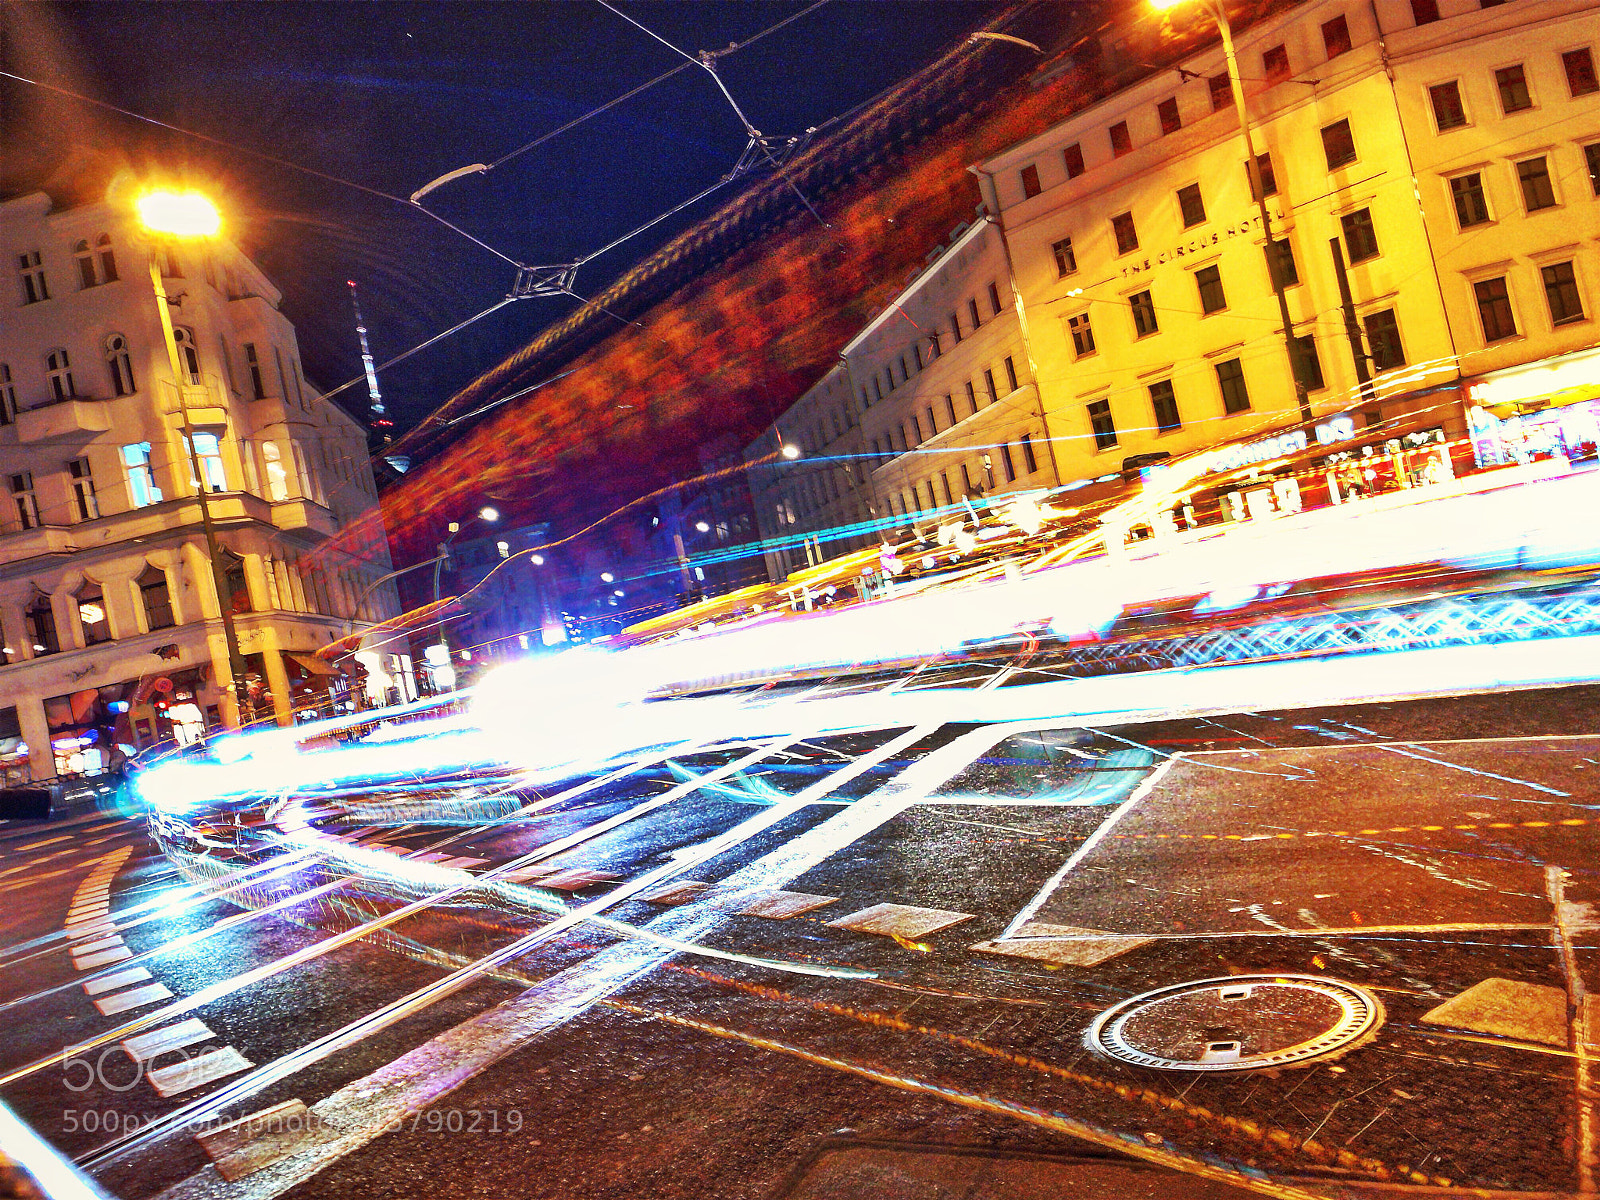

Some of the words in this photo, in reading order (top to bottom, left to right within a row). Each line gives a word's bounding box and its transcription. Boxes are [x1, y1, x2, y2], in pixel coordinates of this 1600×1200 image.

[1122, 259, 1151, 278] THE
[1158, 232, 1219, 265] CIRCUS
[1228, 208, 1285, 239] HOTEL
